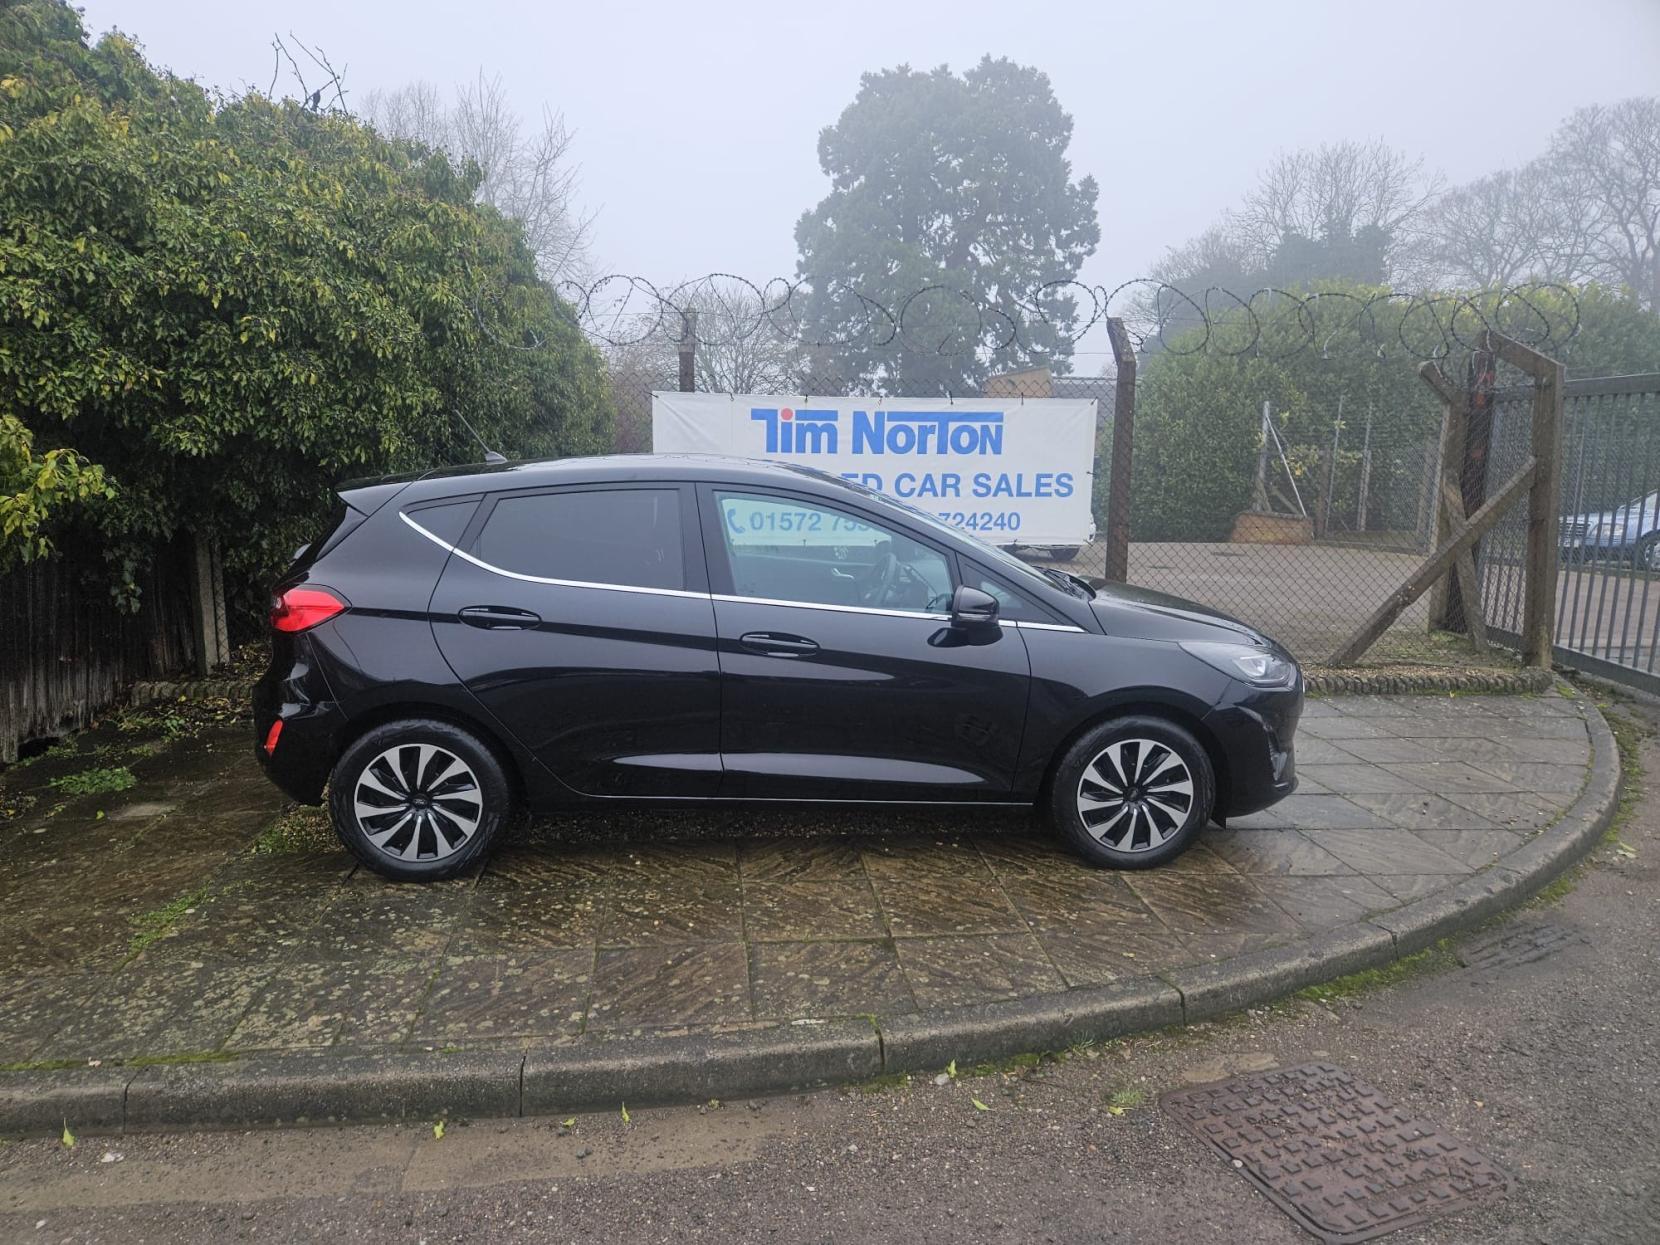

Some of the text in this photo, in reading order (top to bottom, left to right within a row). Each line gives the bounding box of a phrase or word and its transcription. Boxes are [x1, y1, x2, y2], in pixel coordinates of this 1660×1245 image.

[751, 407, 838, 454] Tim
[895, 472, 961, 498] CAR
[972, 472, 1074, 498] SALES
[750, 511, 821, 532] 01572
